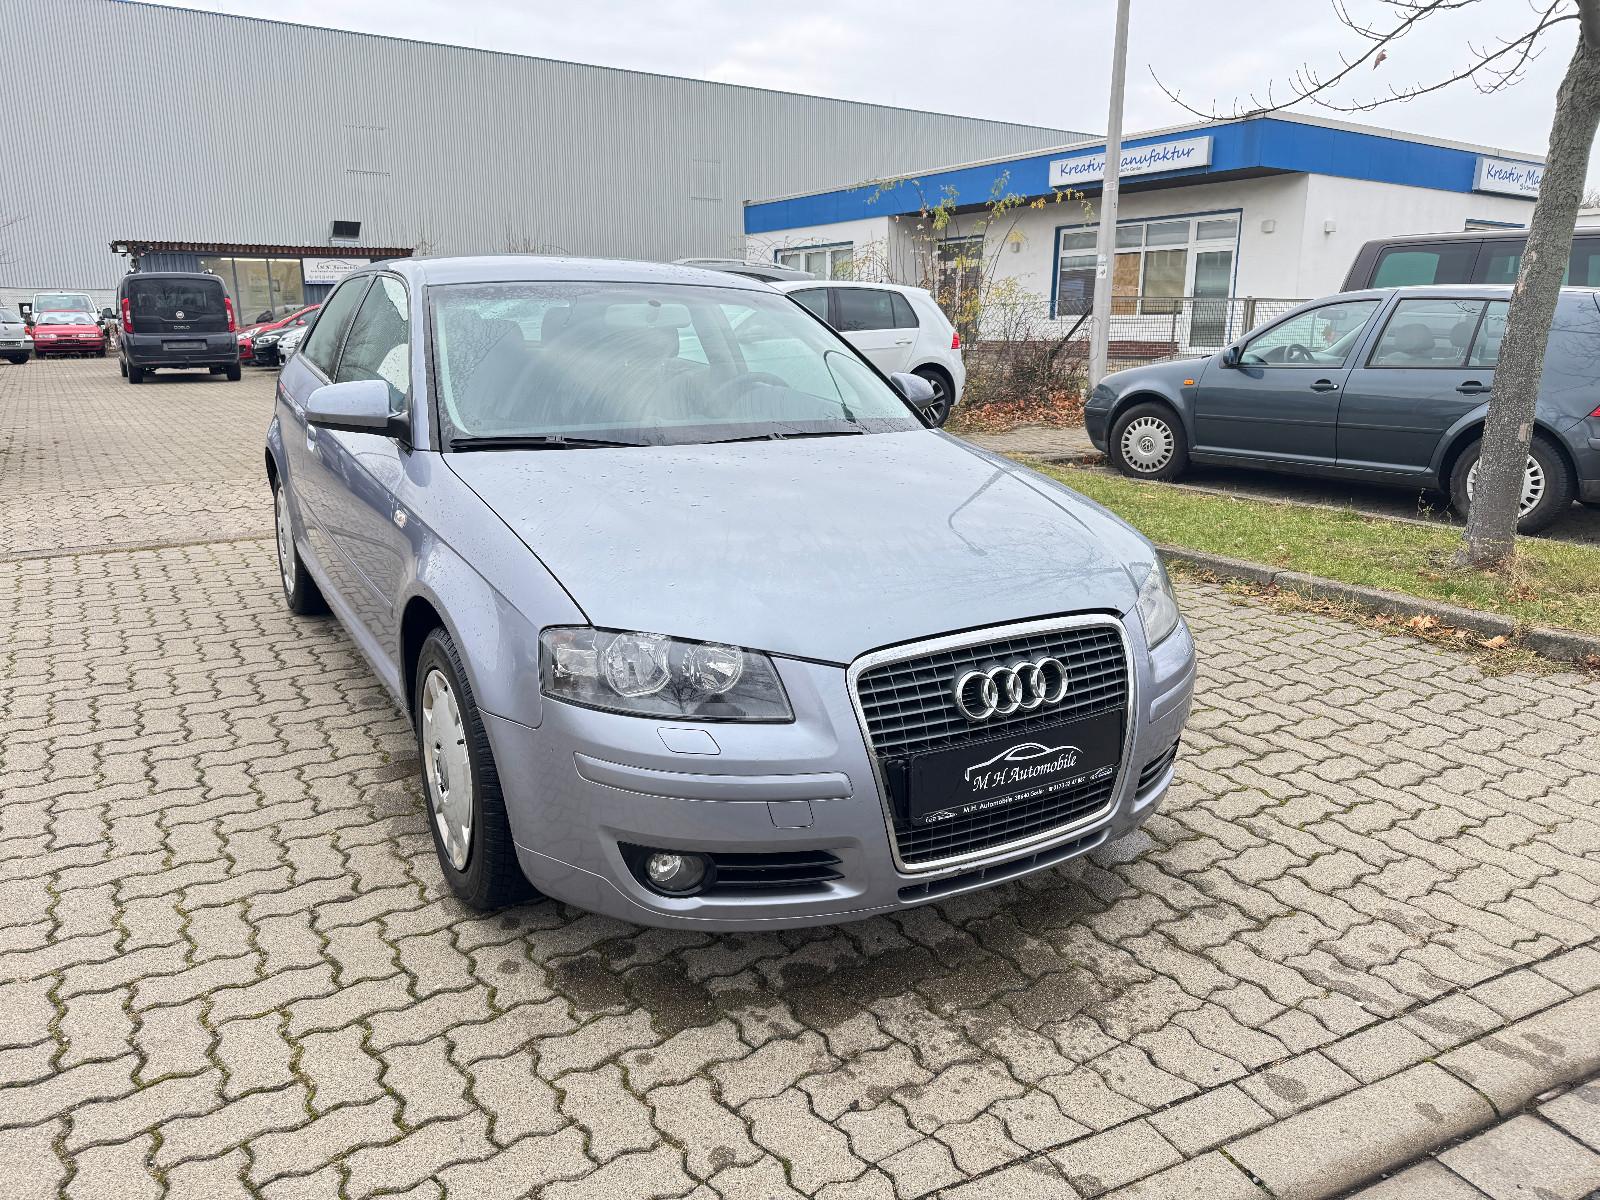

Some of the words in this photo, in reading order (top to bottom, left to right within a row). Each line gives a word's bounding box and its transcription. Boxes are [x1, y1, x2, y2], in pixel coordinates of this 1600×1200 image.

[1120, 145, 1195, 167] anufaktur
[1487, 163, 1524, 184] Kreativ
[972, 771, 992, 792] M
[991, 767, 1009, 787] H
[1007, 750, 1077, 784] Automobile
[979, 795, 1013, 811] Automobile
